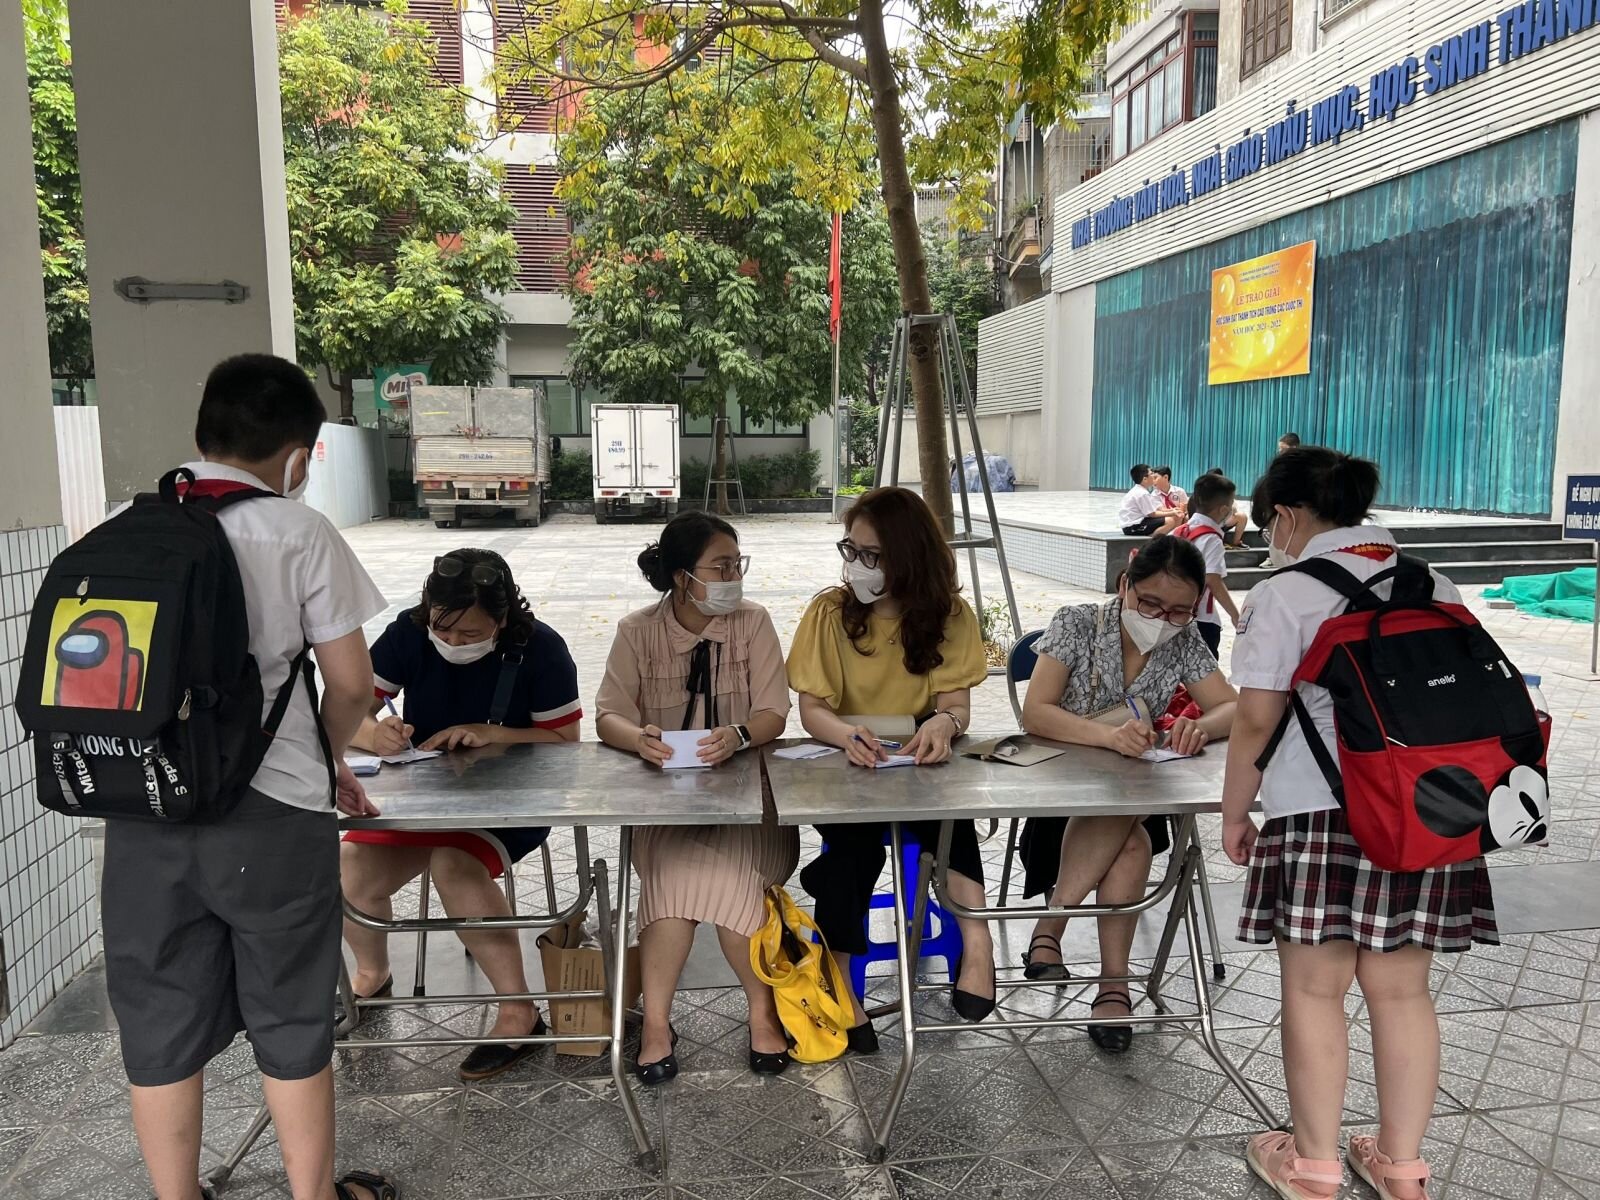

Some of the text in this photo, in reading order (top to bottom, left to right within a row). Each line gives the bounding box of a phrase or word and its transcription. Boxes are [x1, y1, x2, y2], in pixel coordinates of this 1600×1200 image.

[1071, 208, 1092, 250] NHÀ
[1093, 194, 1133, 241] TRƯỜNG
[1134, 178, 1159, 222] VĂN
[1191, 143, 1223, 198] NHÀ
[1225, 127, 1263, 184] GIÁO
[1265, 99, 1309, 167] MẪU
[1368, 56, 1420, 121] HỌC
[1422, 18, 1492, 95] SINH
[75, 734, 124, 757] MONG
